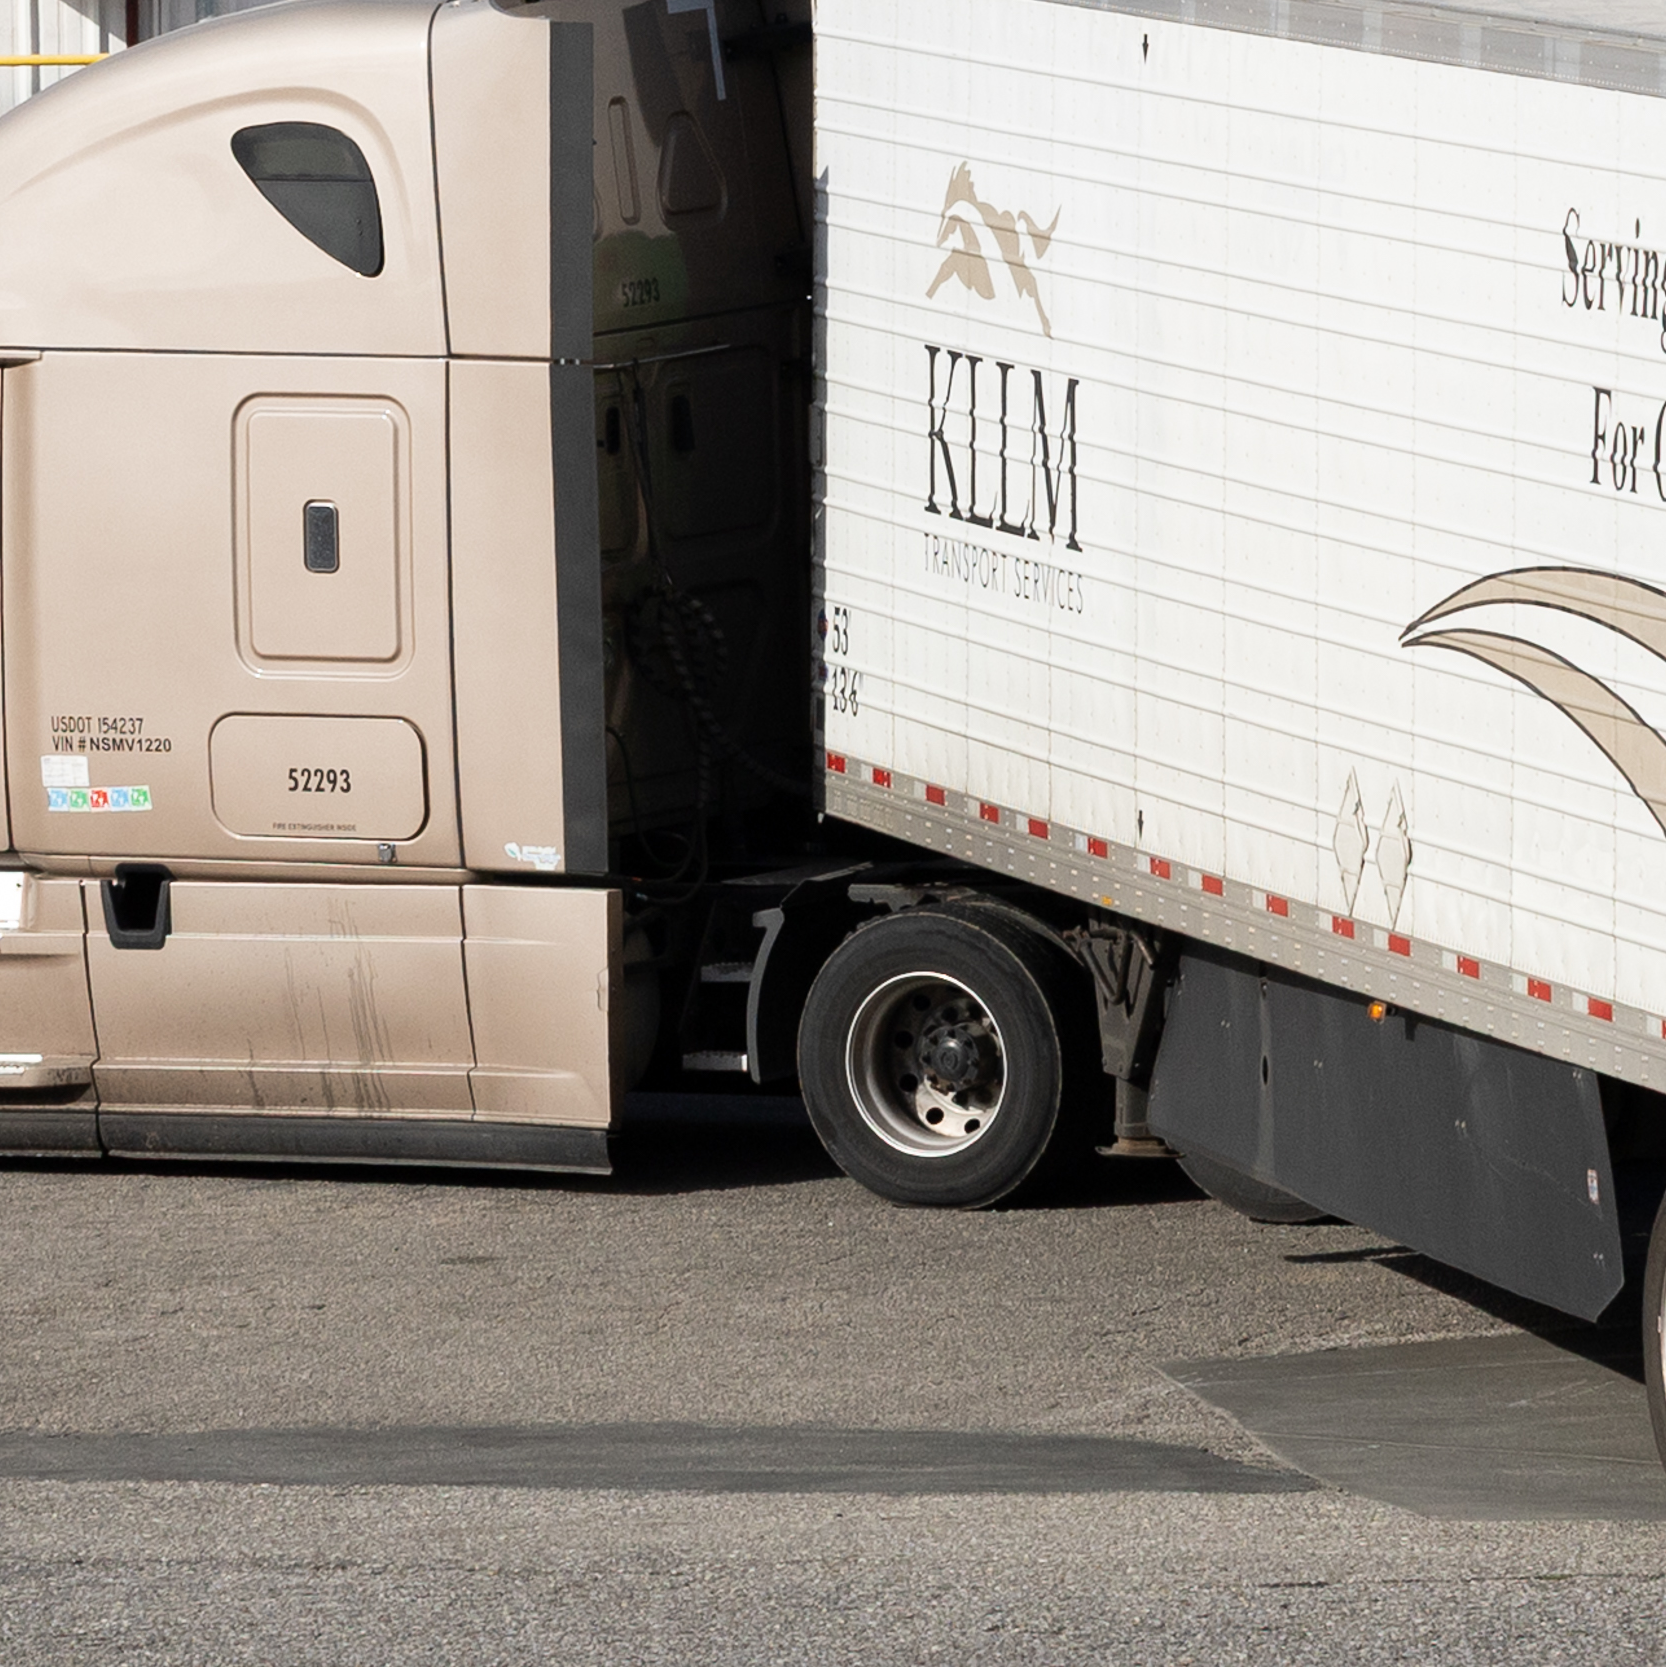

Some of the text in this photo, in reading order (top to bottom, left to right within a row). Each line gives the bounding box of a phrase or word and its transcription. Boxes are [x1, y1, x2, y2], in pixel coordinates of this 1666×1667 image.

[621, 277, 661, 308] 52293
[923, 343, 1084, 553] KLLM
[1589, 385, 1646, 494] For
[923, 532, 1084, 615] TRANSPORT SERVICES
[51, 716, 144, 735] USDOT 154237
[52, 736, 74, 752] VIN
[90, 737, 172, 752] NSMV1220
[288, 767, 352, 793] 52293
[272, 822, 357, 832] FIRE EXTINGUISHER INSIDE
